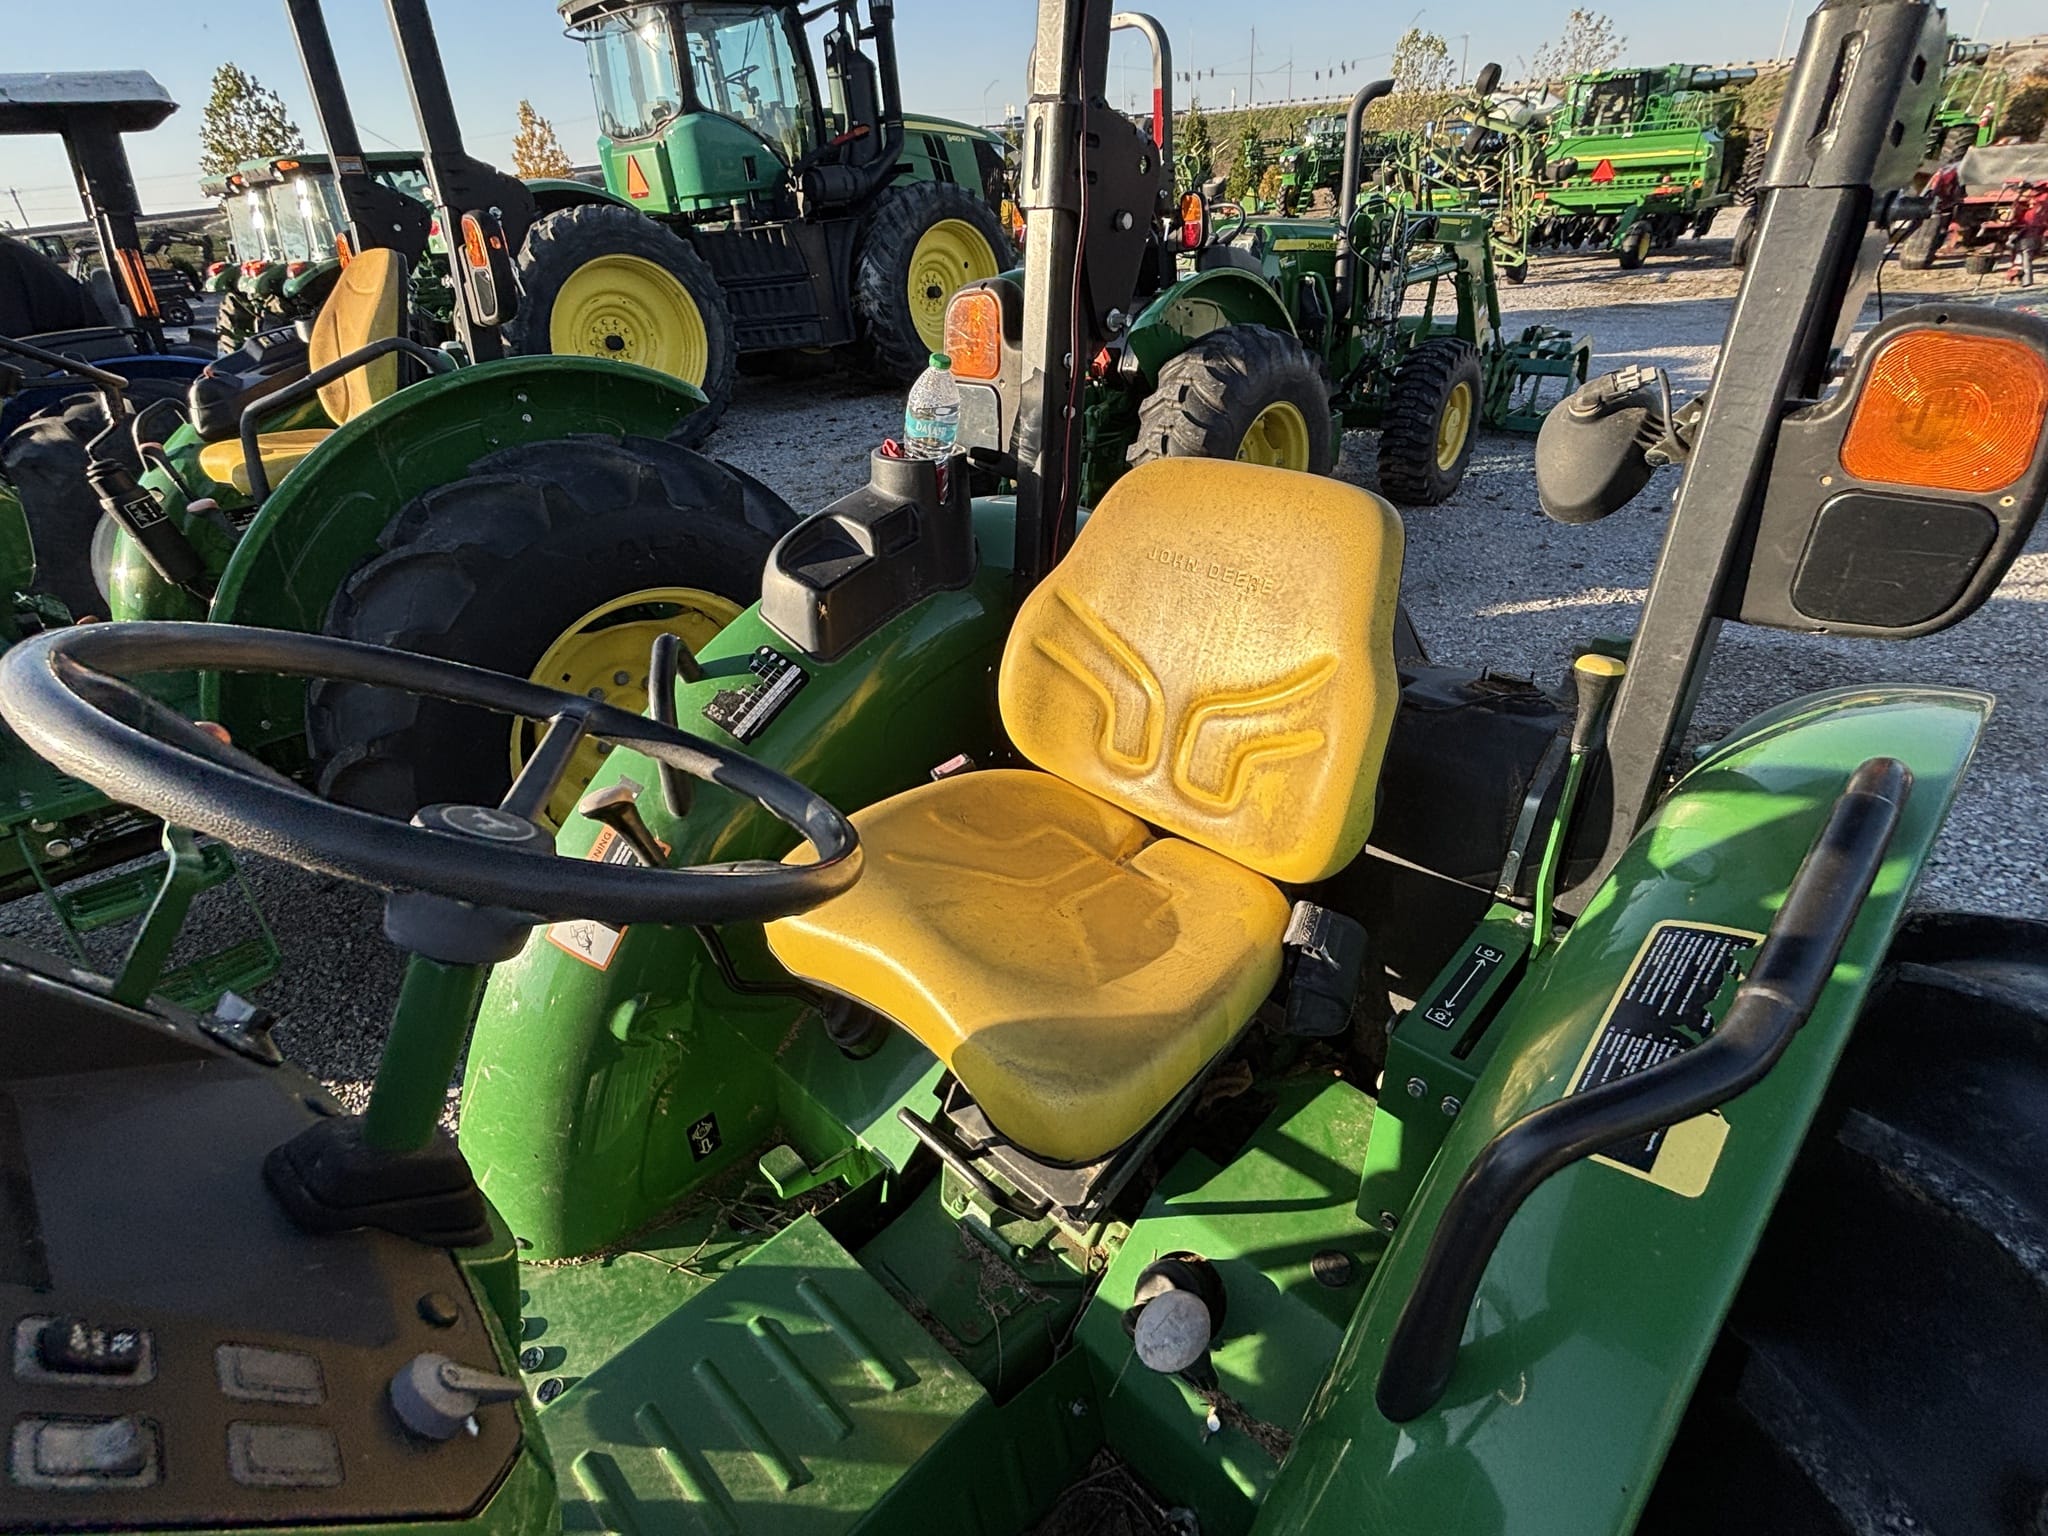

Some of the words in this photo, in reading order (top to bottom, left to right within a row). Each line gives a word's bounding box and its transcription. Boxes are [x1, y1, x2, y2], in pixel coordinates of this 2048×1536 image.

[1147, 546, 1198, 573] JOHN
[1207, 563, 1274, 594] DEERE
[592, 831, 613, 860] NING
